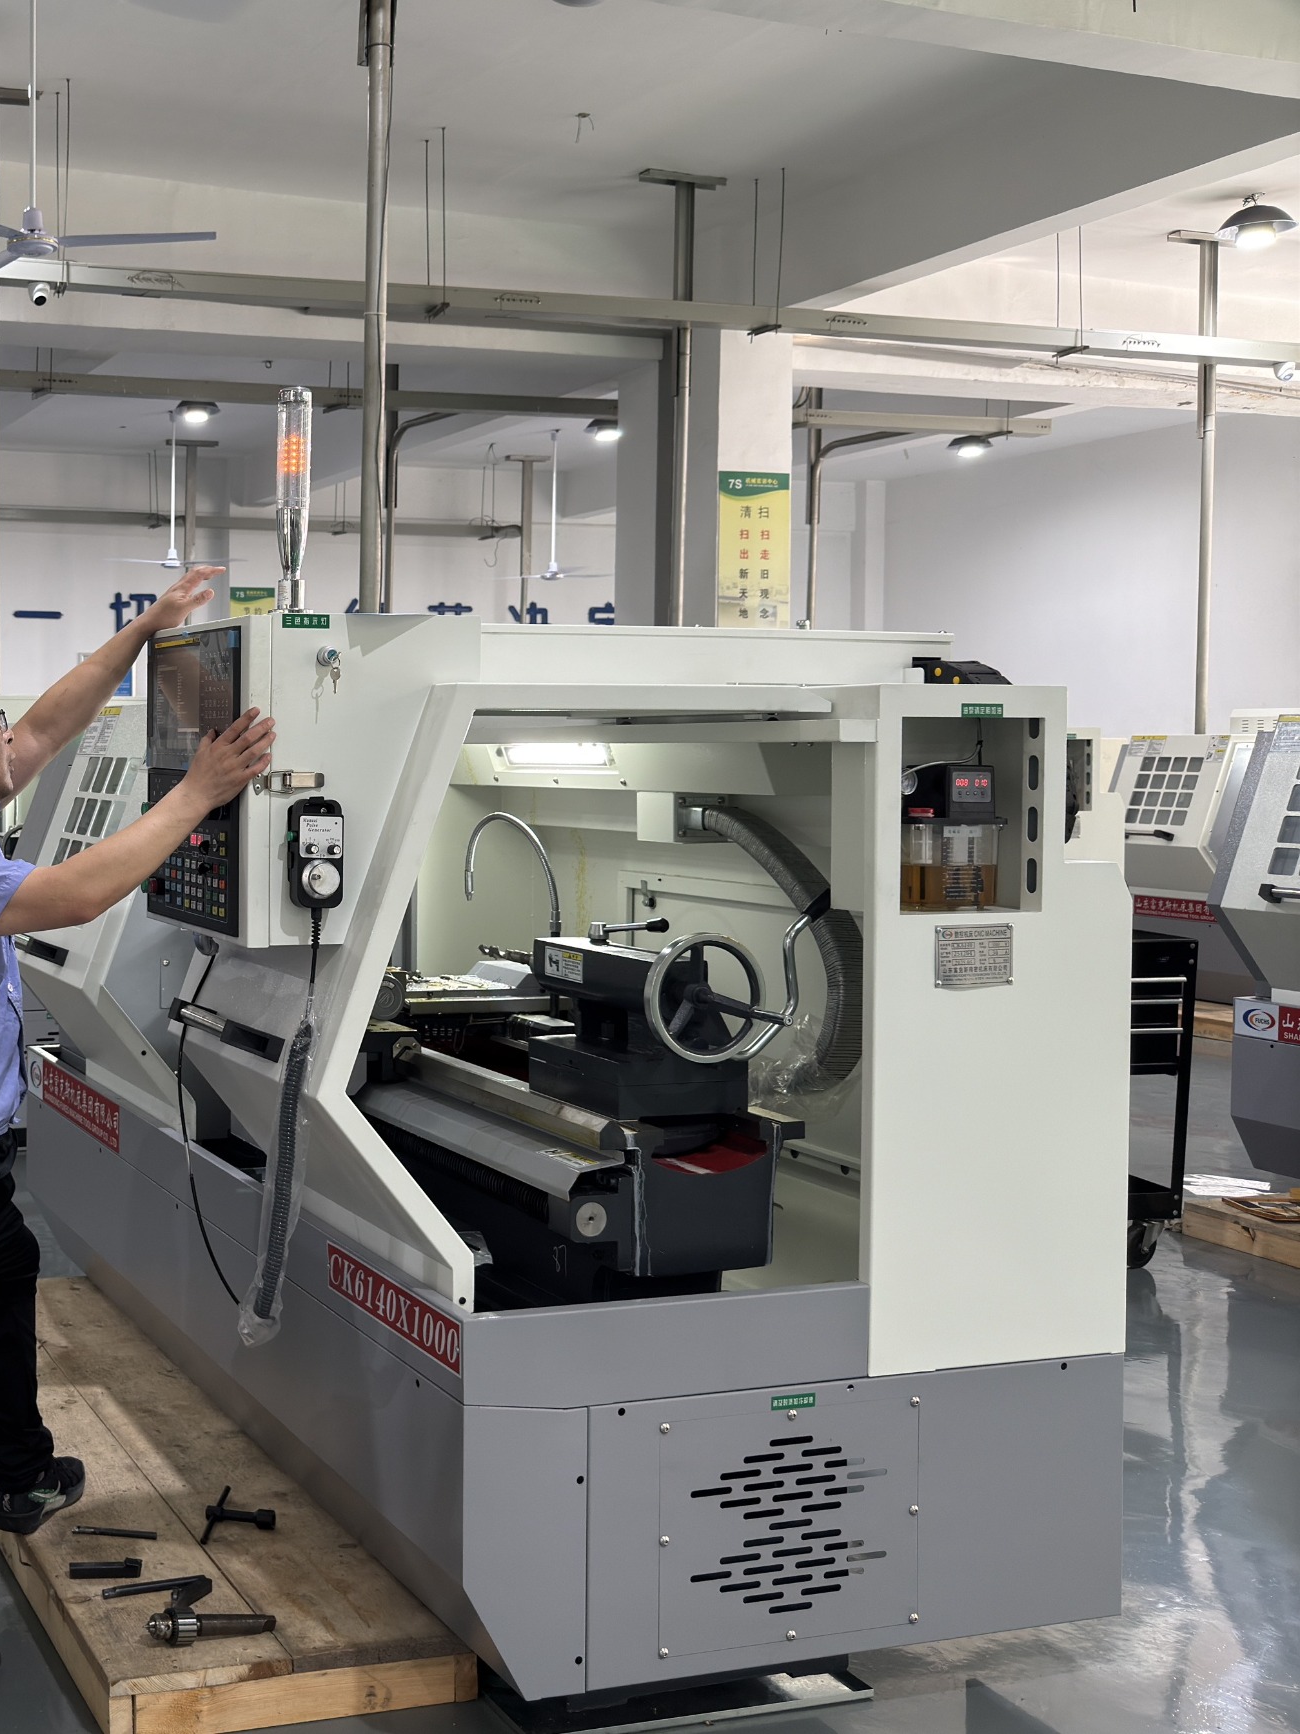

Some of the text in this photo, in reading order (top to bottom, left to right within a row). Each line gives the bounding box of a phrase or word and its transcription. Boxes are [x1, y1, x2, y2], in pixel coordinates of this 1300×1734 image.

[728, 478, 742, 489] 7S
[285, 616, 327, 626] 三色指示灯
[1254, 1017, 1270, 1025] FUCHS
[1283, 1031, 1300, 1041] SHA
[330, 1254, 458, 1363] CK6140X1000
